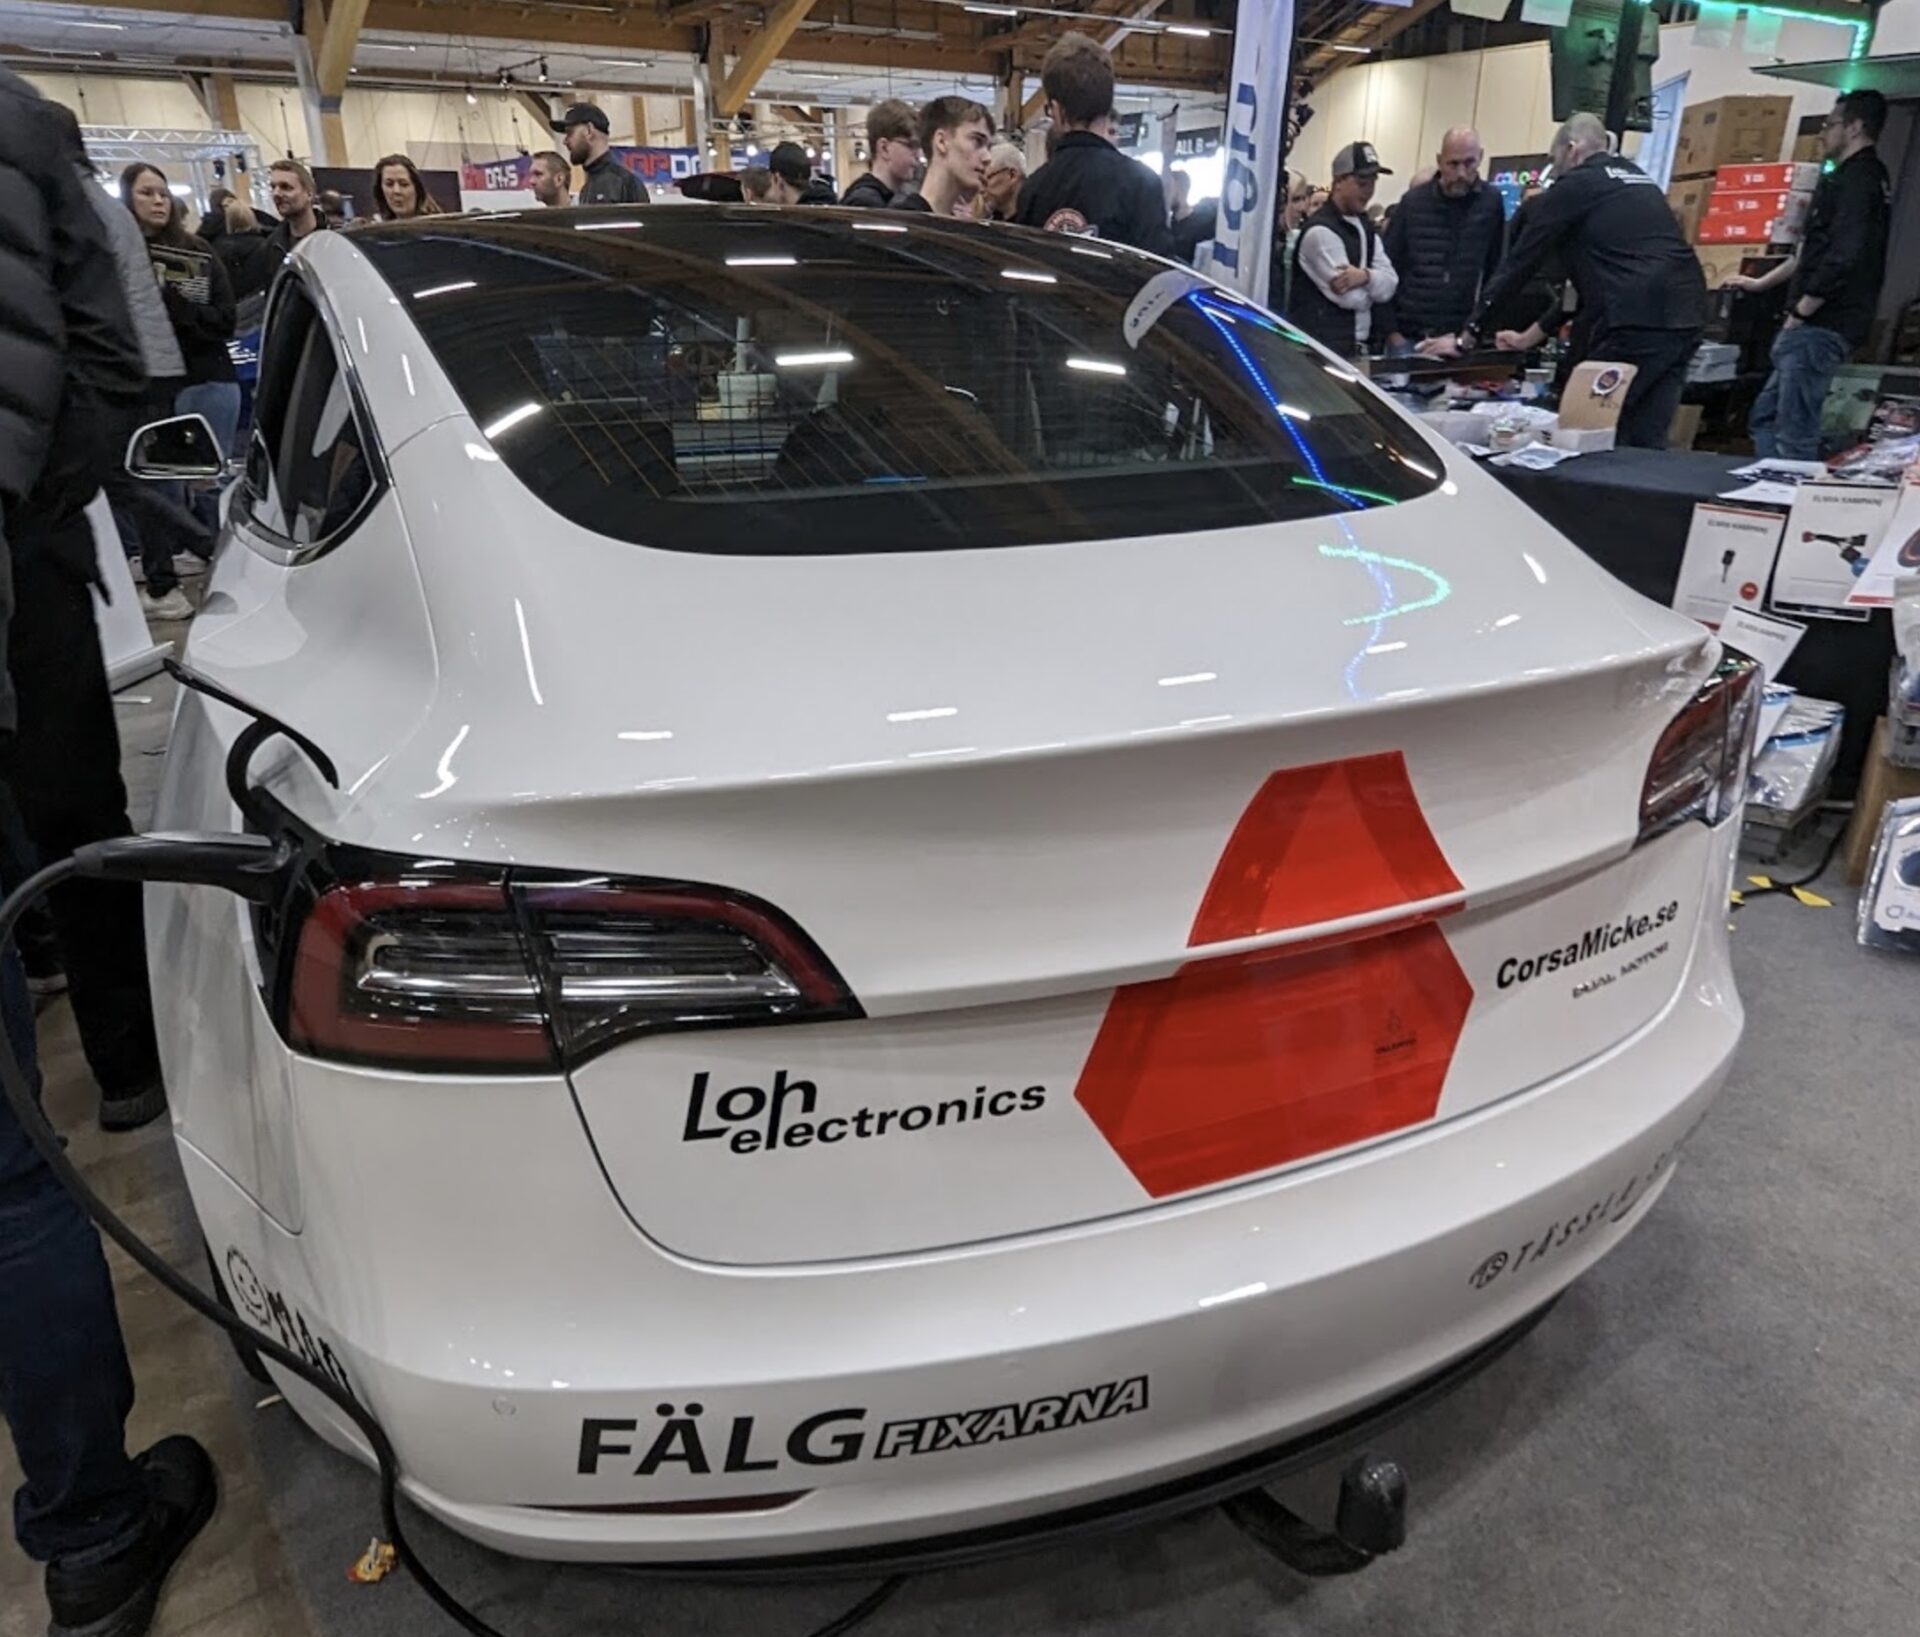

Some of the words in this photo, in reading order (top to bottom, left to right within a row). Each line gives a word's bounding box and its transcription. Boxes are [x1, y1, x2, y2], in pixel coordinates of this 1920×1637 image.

[1496, 900, 1679, 990] CorsaMicke.se
[682, 1069, 818, 1150] Loh
[729, 1084, 1047, 1155] electronics
[576, 1402, 867, 1476] FÄLG
[873, 1374, 1149, 1460] FIXARNA
